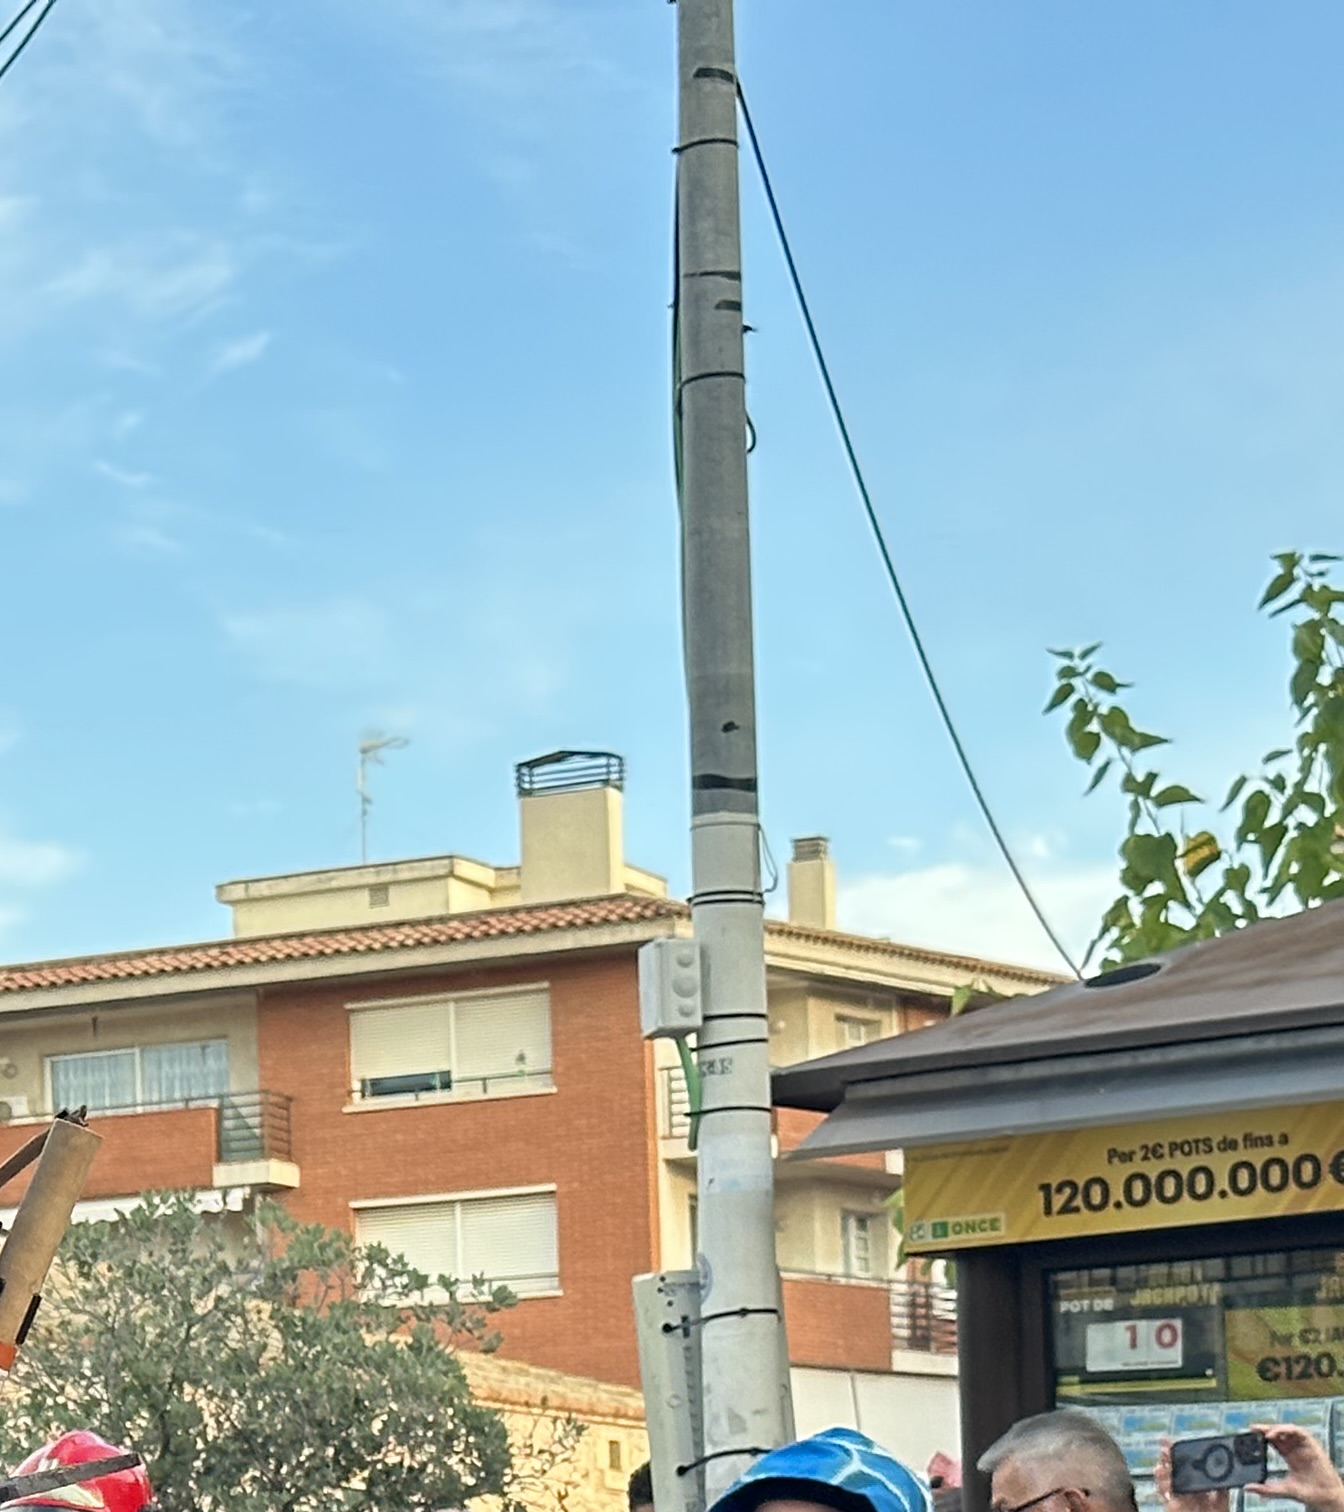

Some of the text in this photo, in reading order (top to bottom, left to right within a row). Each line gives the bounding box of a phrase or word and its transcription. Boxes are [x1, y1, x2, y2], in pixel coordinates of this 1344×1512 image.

[1107, 1132, 1289, 1164] Per 2€ POTS de fins a
[1038, 1153, 1322, 1217] 120.000.000
[951, 1217, 1001, 1236] ONCE
[1059, 1299, 1089, 1314] POT
